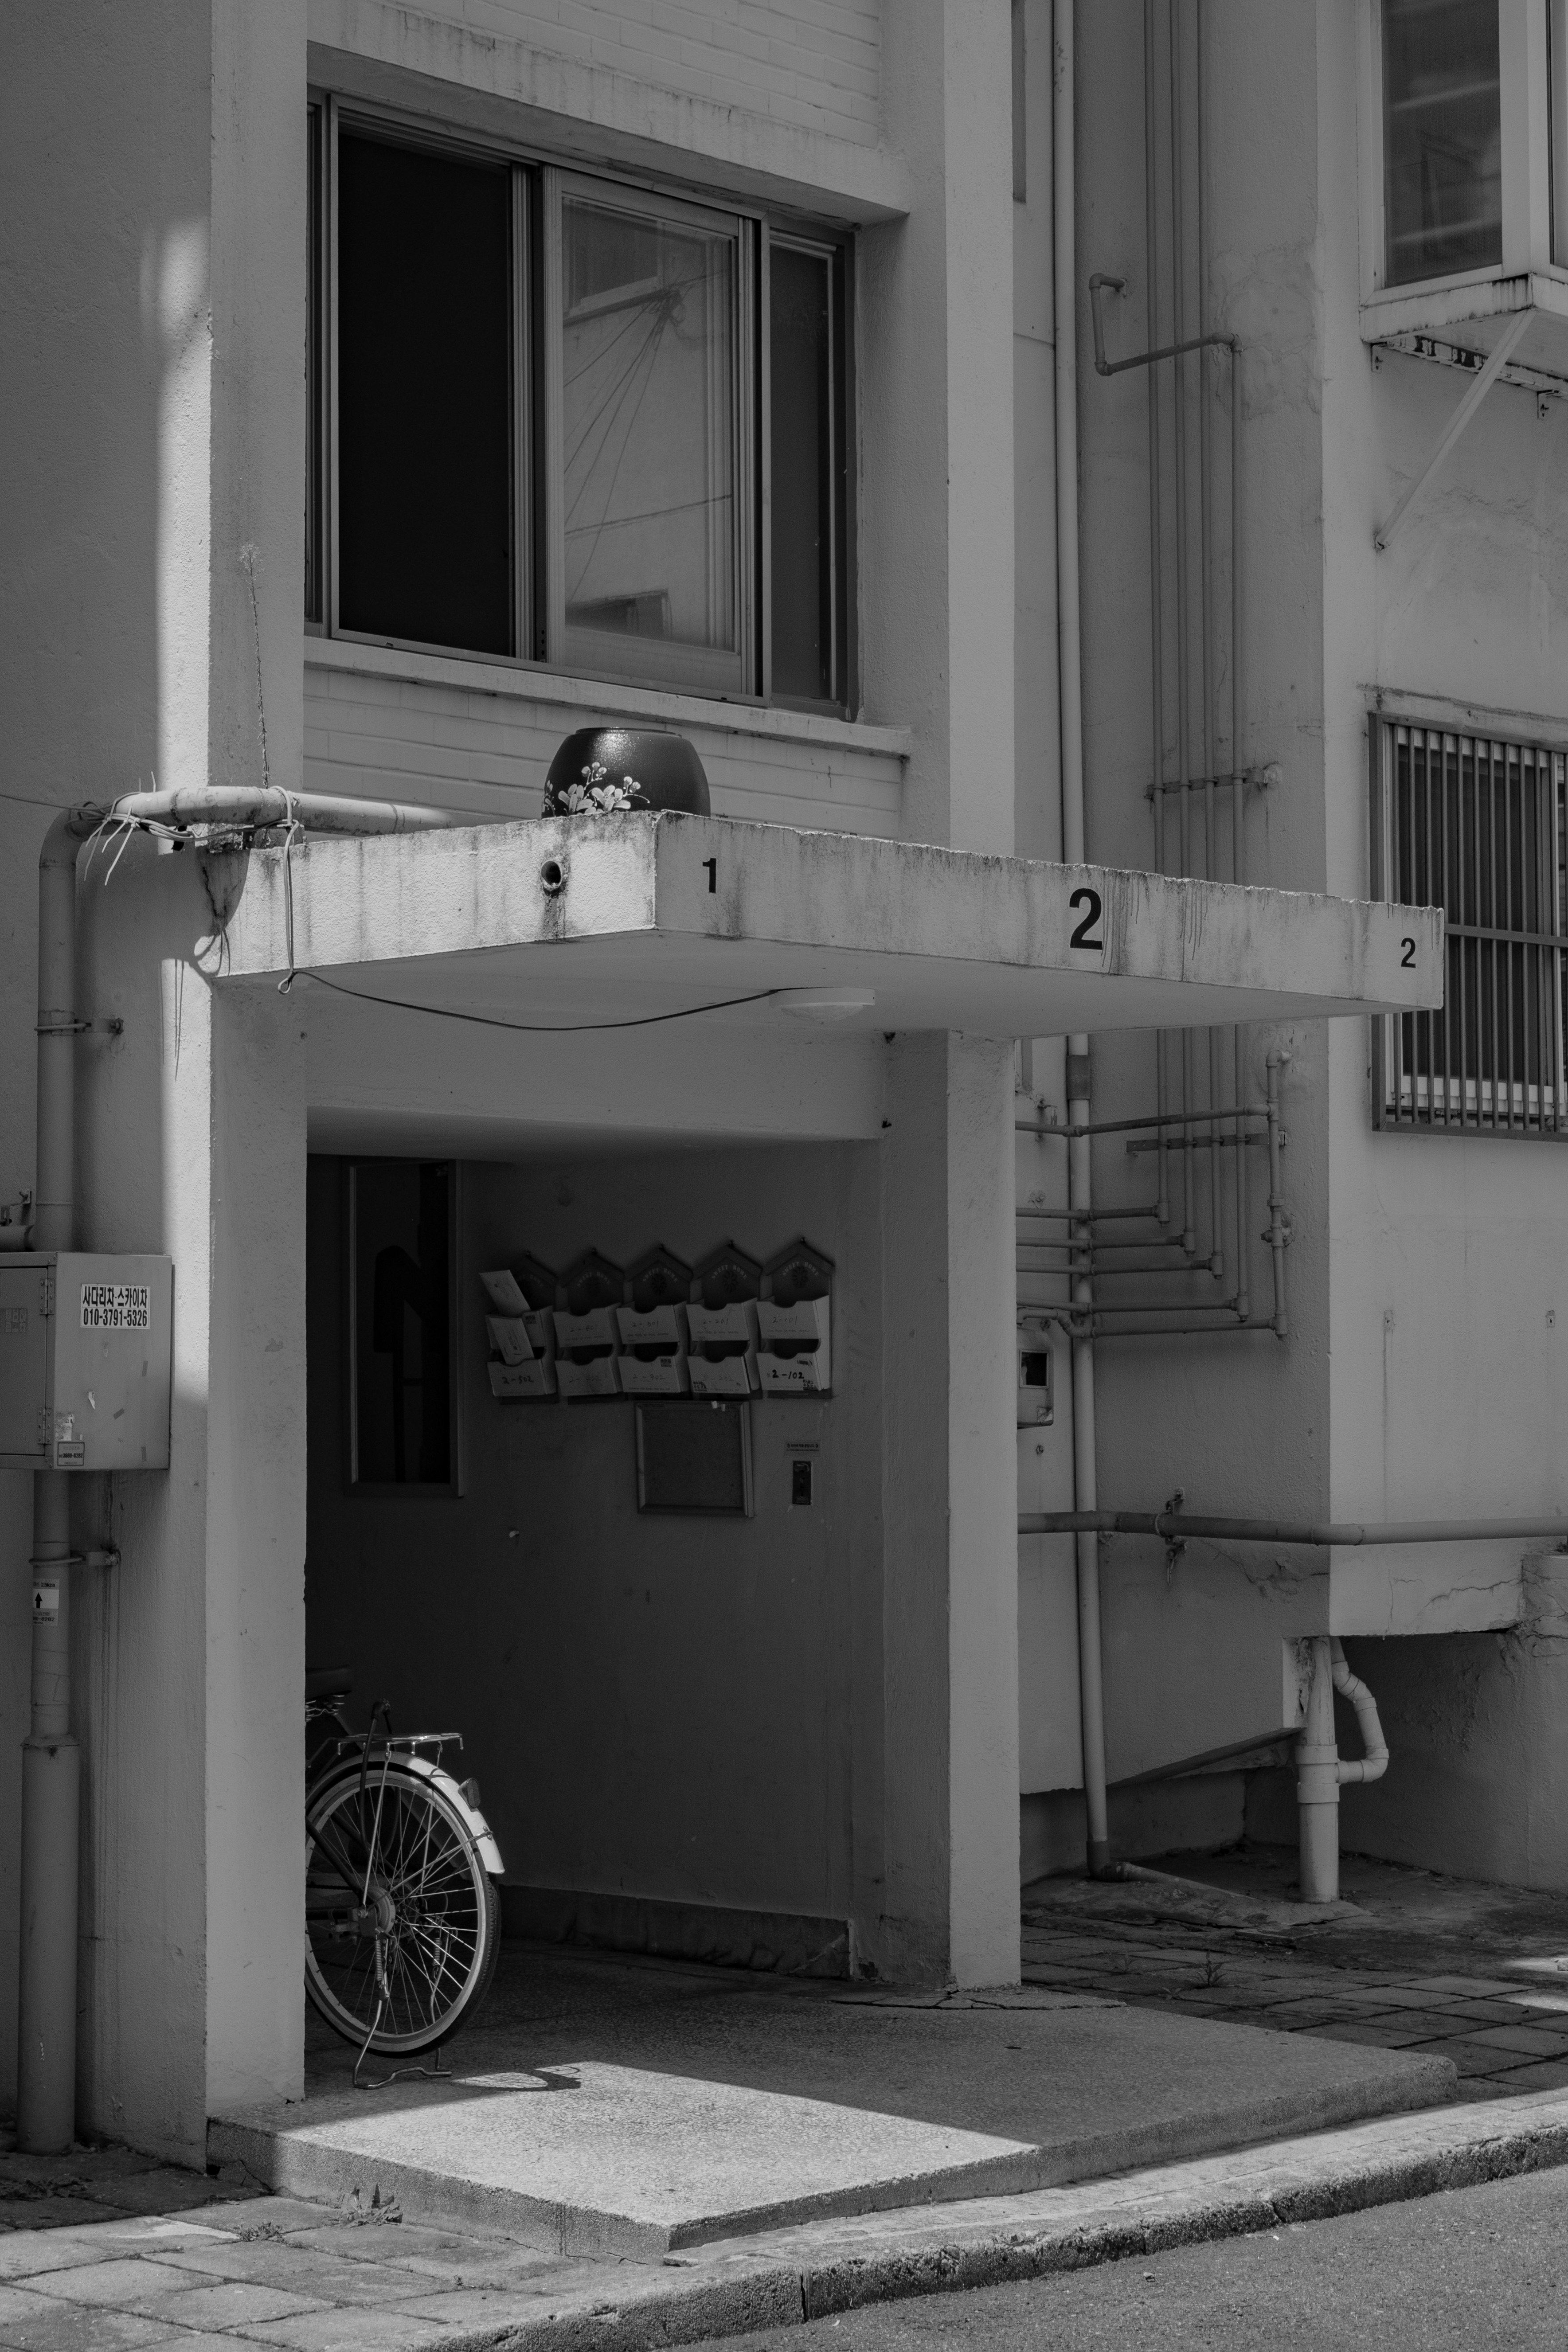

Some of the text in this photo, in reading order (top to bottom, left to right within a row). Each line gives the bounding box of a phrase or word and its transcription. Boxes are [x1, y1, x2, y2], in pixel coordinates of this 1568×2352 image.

[702, 858, 716, 894] 1
[1069, 888, 1103, 950] 2
[1401, 938, 1416, 968] 2
[642, 1268, 678, 1283] SWEET HOME
[712, 1264, 747, 1280] SWEET HOME
[782, 1262, 819, 1277] SWEET HOME
[83, 1308, 147, 1327] 010-3791-5326
